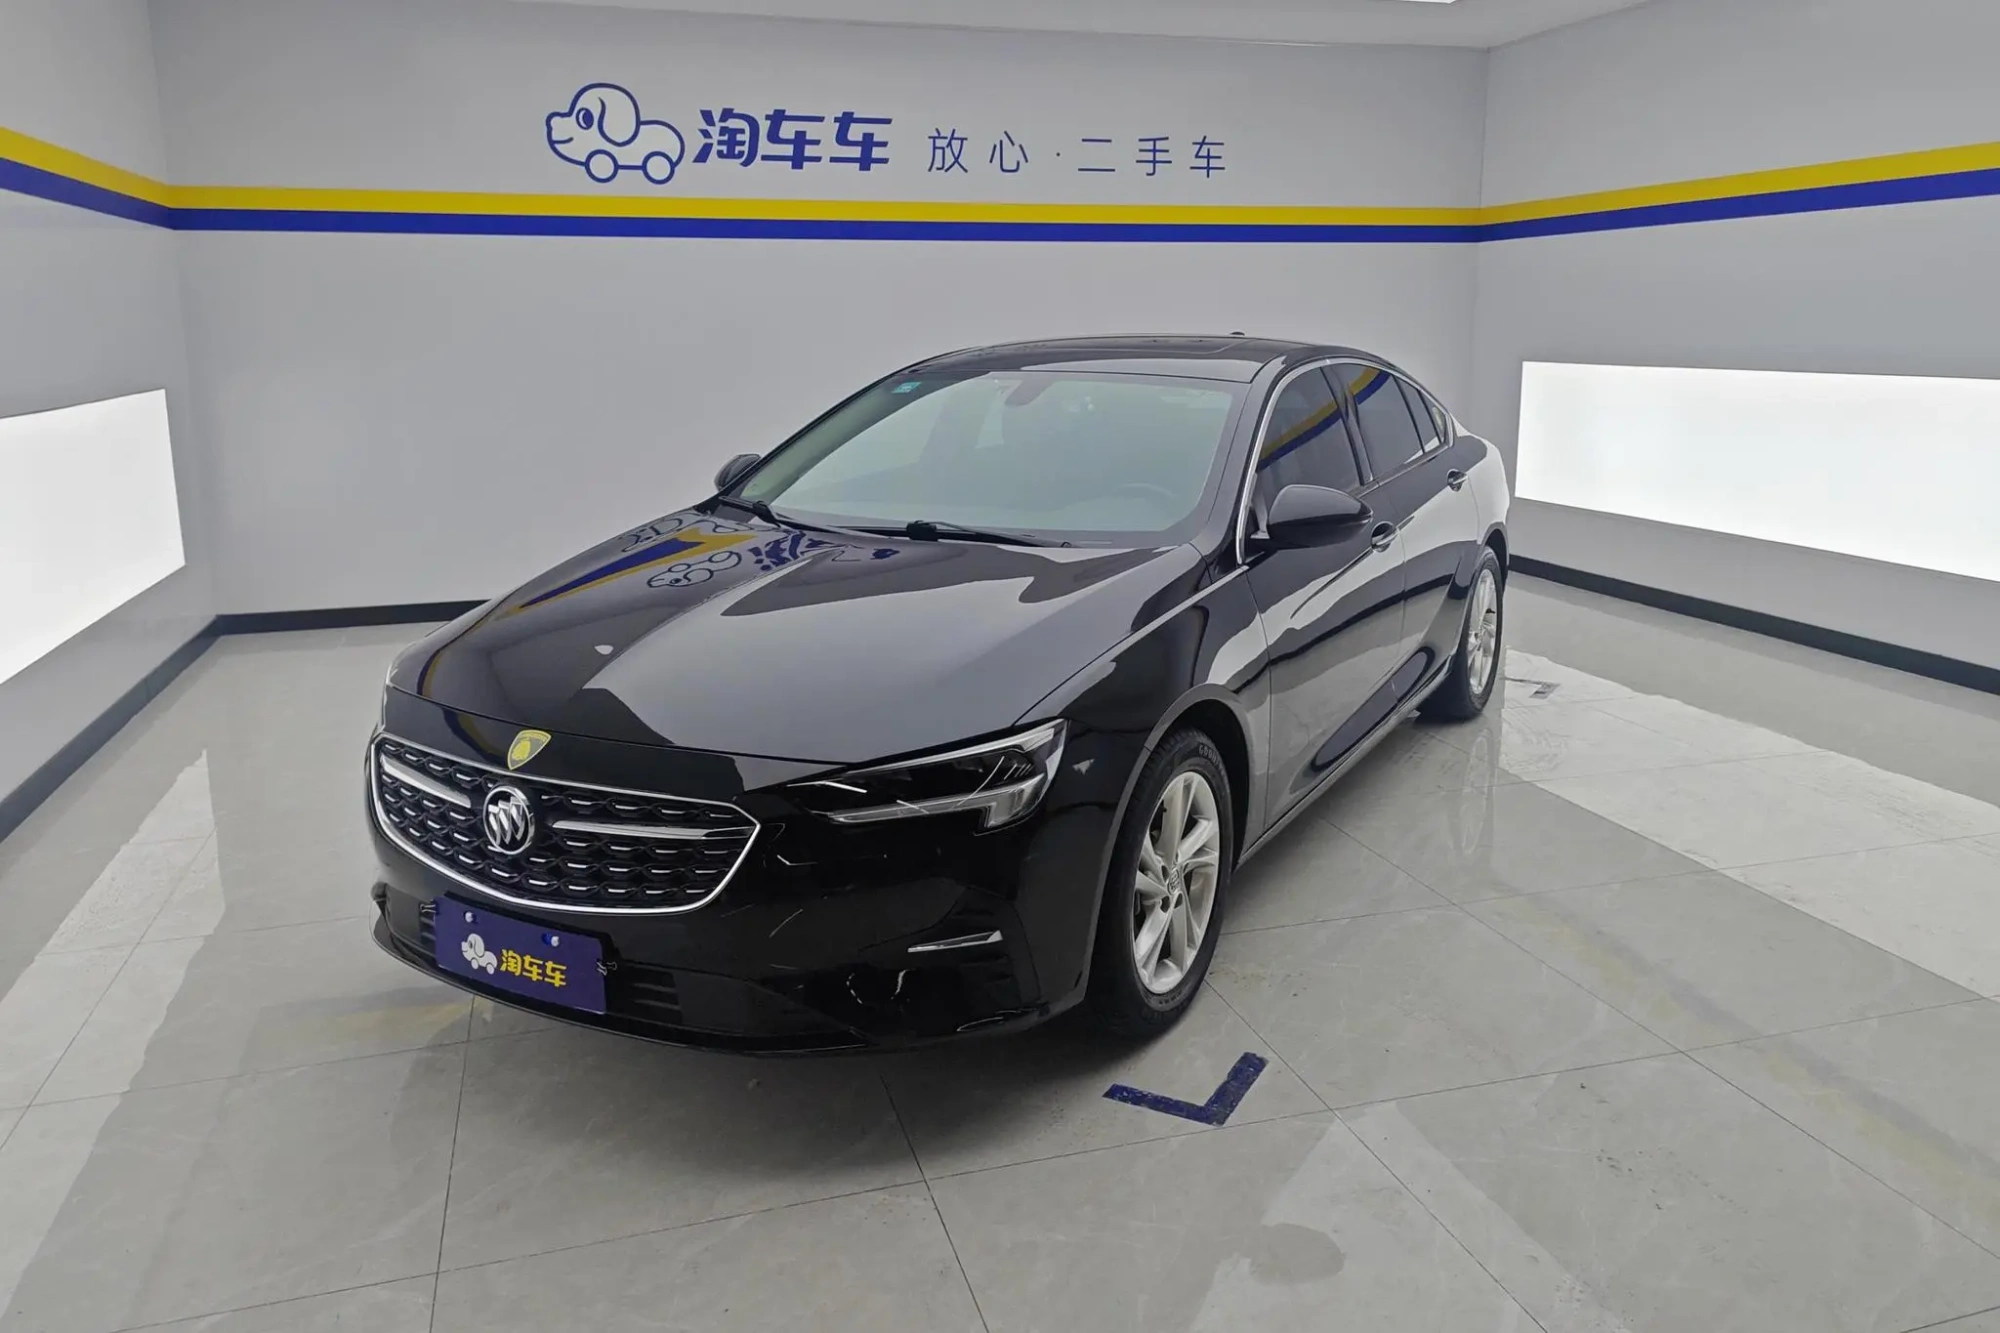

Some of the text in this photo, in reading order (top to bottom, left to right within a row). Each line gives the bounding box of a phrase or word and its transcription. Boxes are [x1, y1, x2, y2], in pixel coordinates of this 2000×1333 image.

[692, 107, 893, 173] 淘车车
[500, 949, 567, 988] 淘车车
